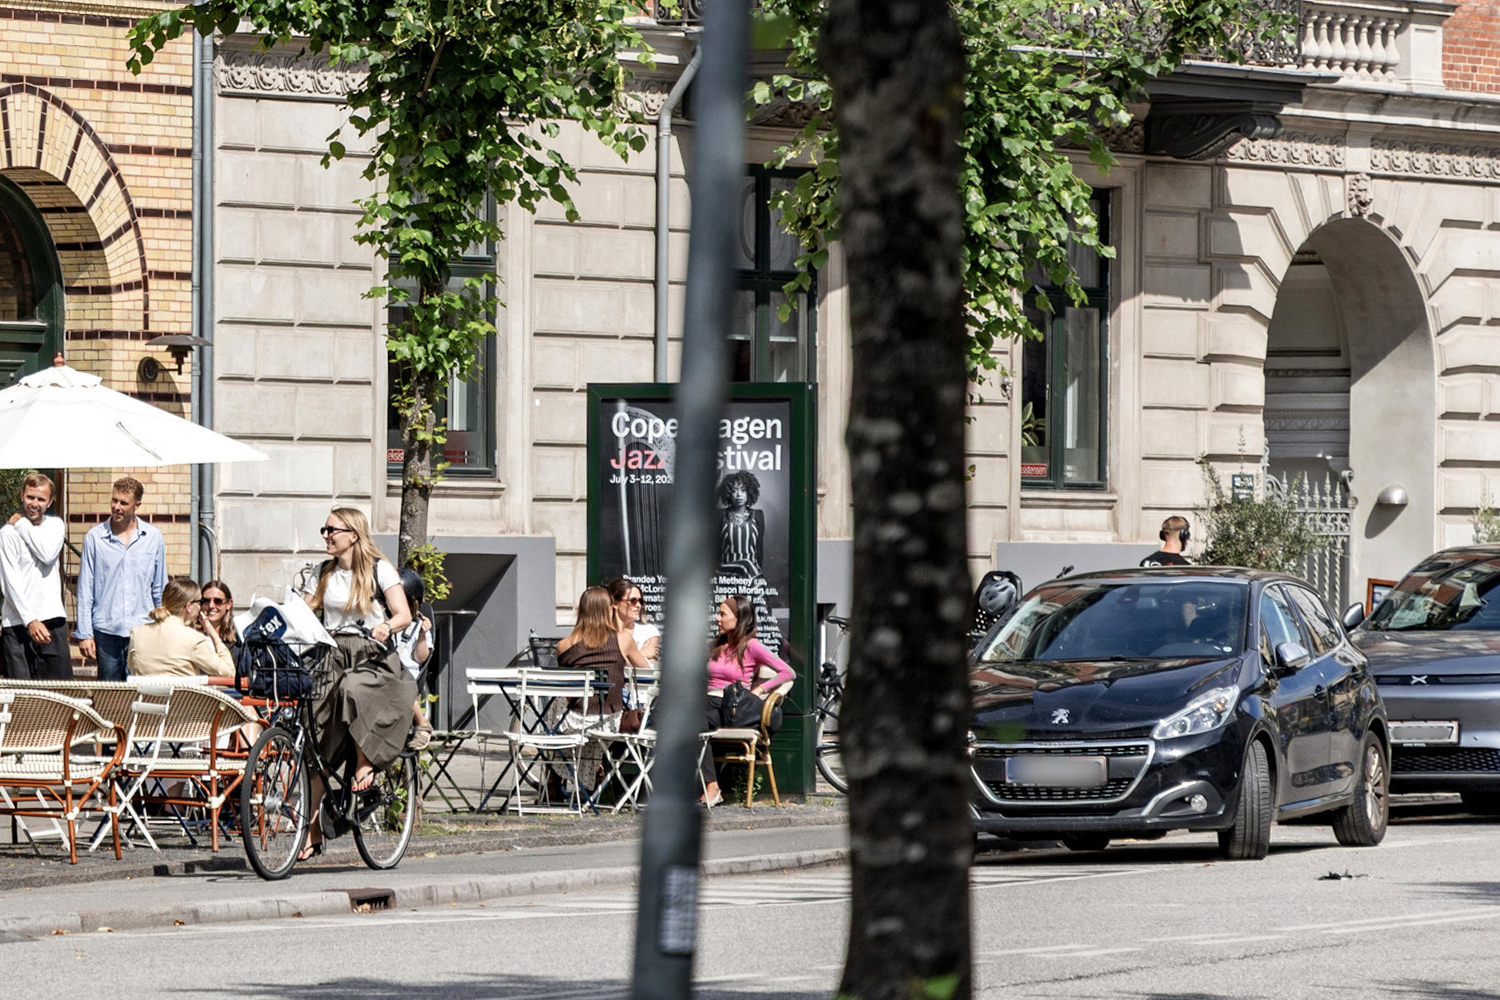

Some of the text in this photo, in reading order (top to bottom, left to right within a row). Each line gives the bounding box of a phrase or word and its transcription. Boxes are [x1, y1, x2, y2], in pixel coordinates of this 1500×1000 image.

[612, 411, 782, 445] Copeagen
[716, 444, 781, 470] stival
[655, 474, 674, 485] 202
[713, 586, 737, 594] Jason
